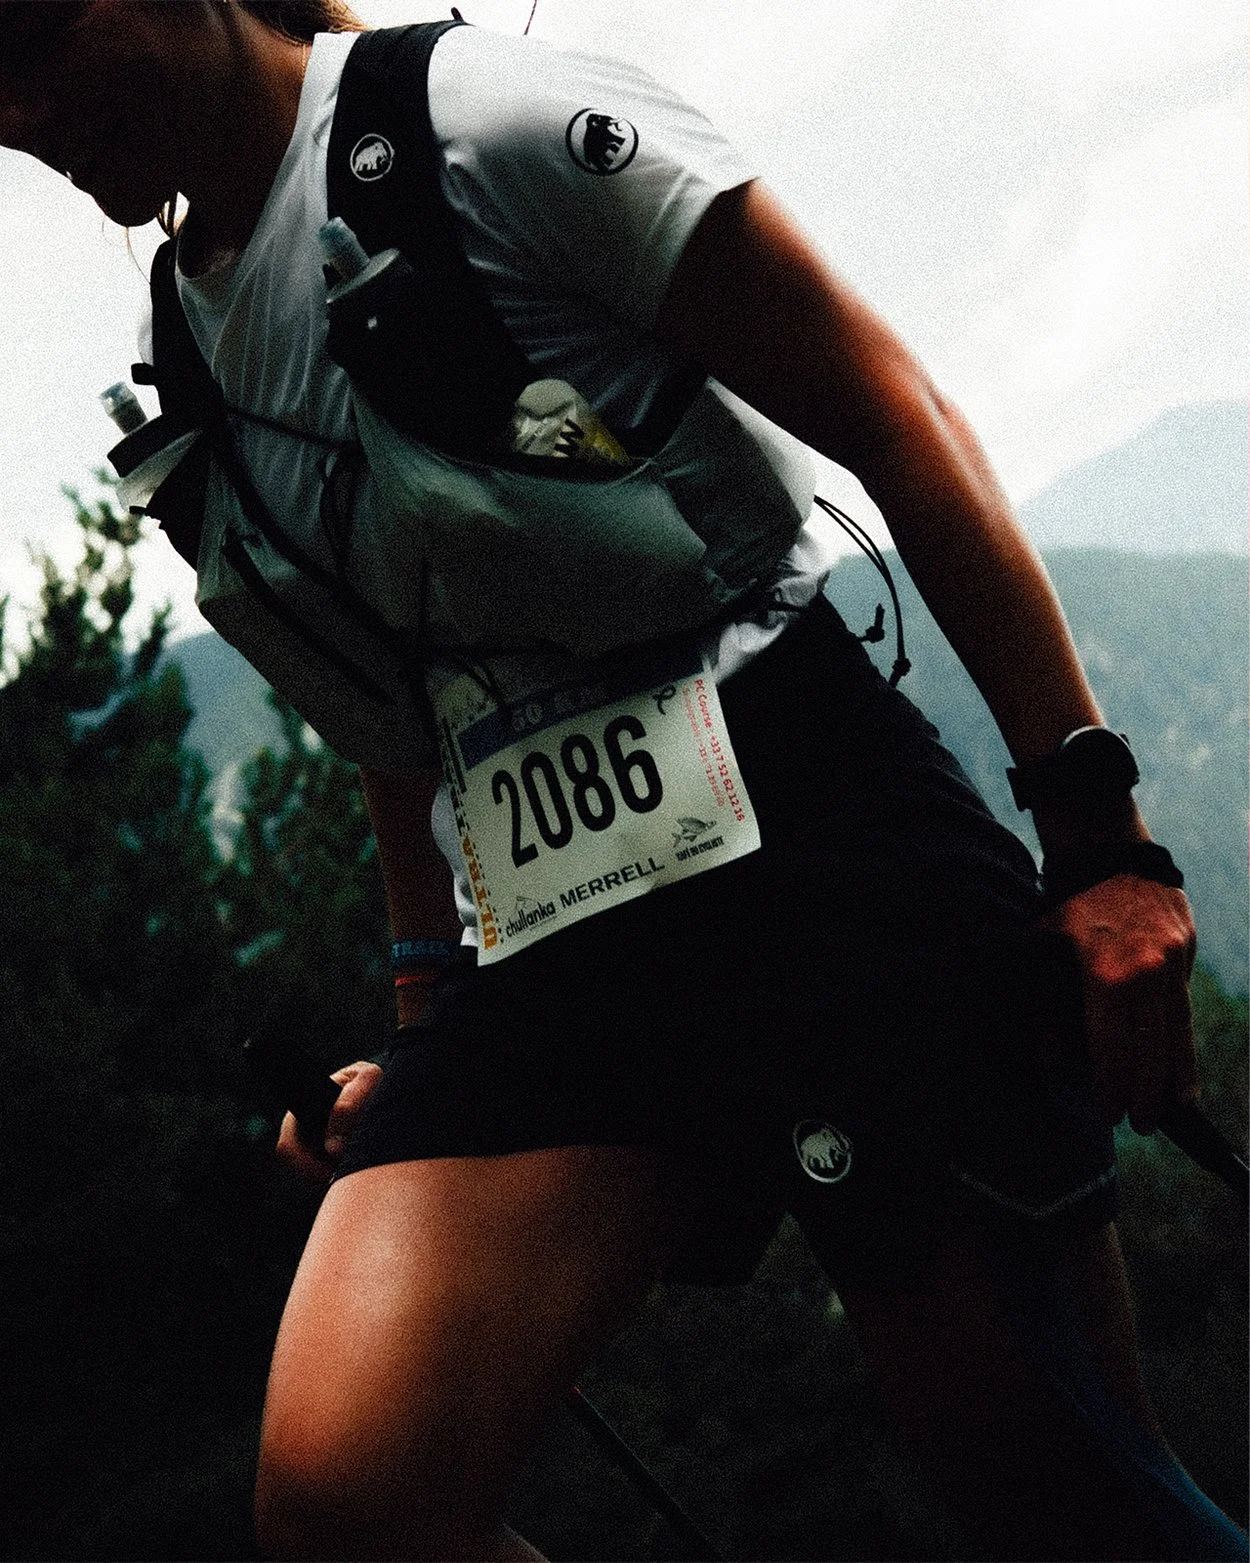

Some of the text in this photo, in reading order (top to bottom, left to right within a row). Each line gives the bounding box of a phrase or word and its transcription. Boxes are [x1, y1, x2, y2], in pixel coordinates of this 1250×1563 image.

[698, 694, 712, 727] Course
[718, 764, 729, 777] 52
[491, 714, 664, 869] 2086
[723, 778, 734, 792] 62
[729, 793, 740, 807] 12
[734, 808, 745, 821] 16
[506, 857, 665, 937] chullanka MERRELL
